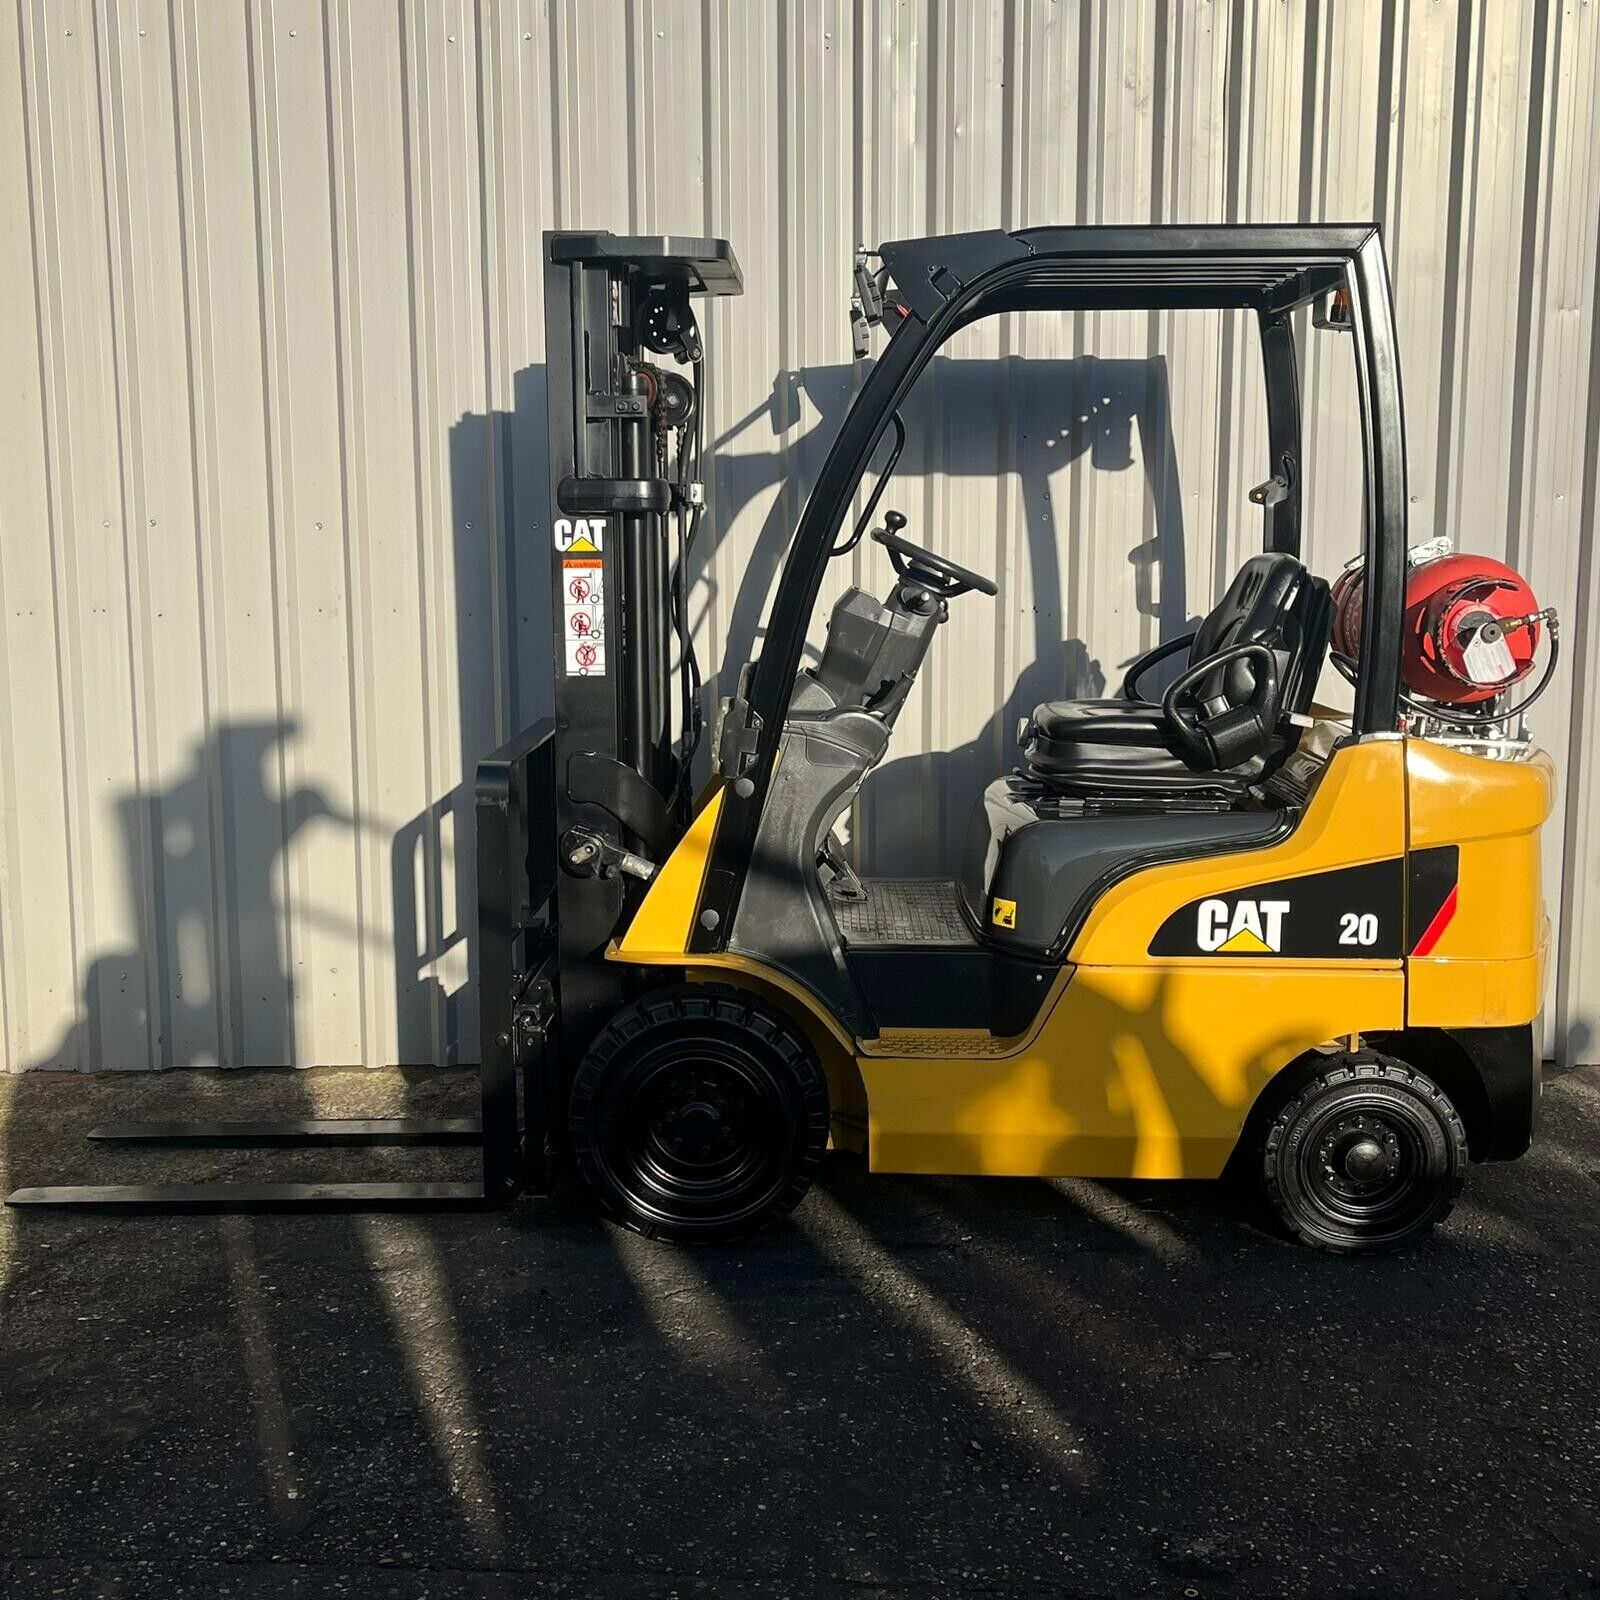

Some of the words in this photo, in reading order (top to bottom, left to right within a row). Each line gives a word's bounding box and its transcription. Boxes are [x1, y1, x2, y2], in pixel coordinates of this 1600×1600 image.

[554, 519, 607, 552] CAT
[1196, 899, 1291, 953] CAT
[1338, 913, 1379, 946] 20
